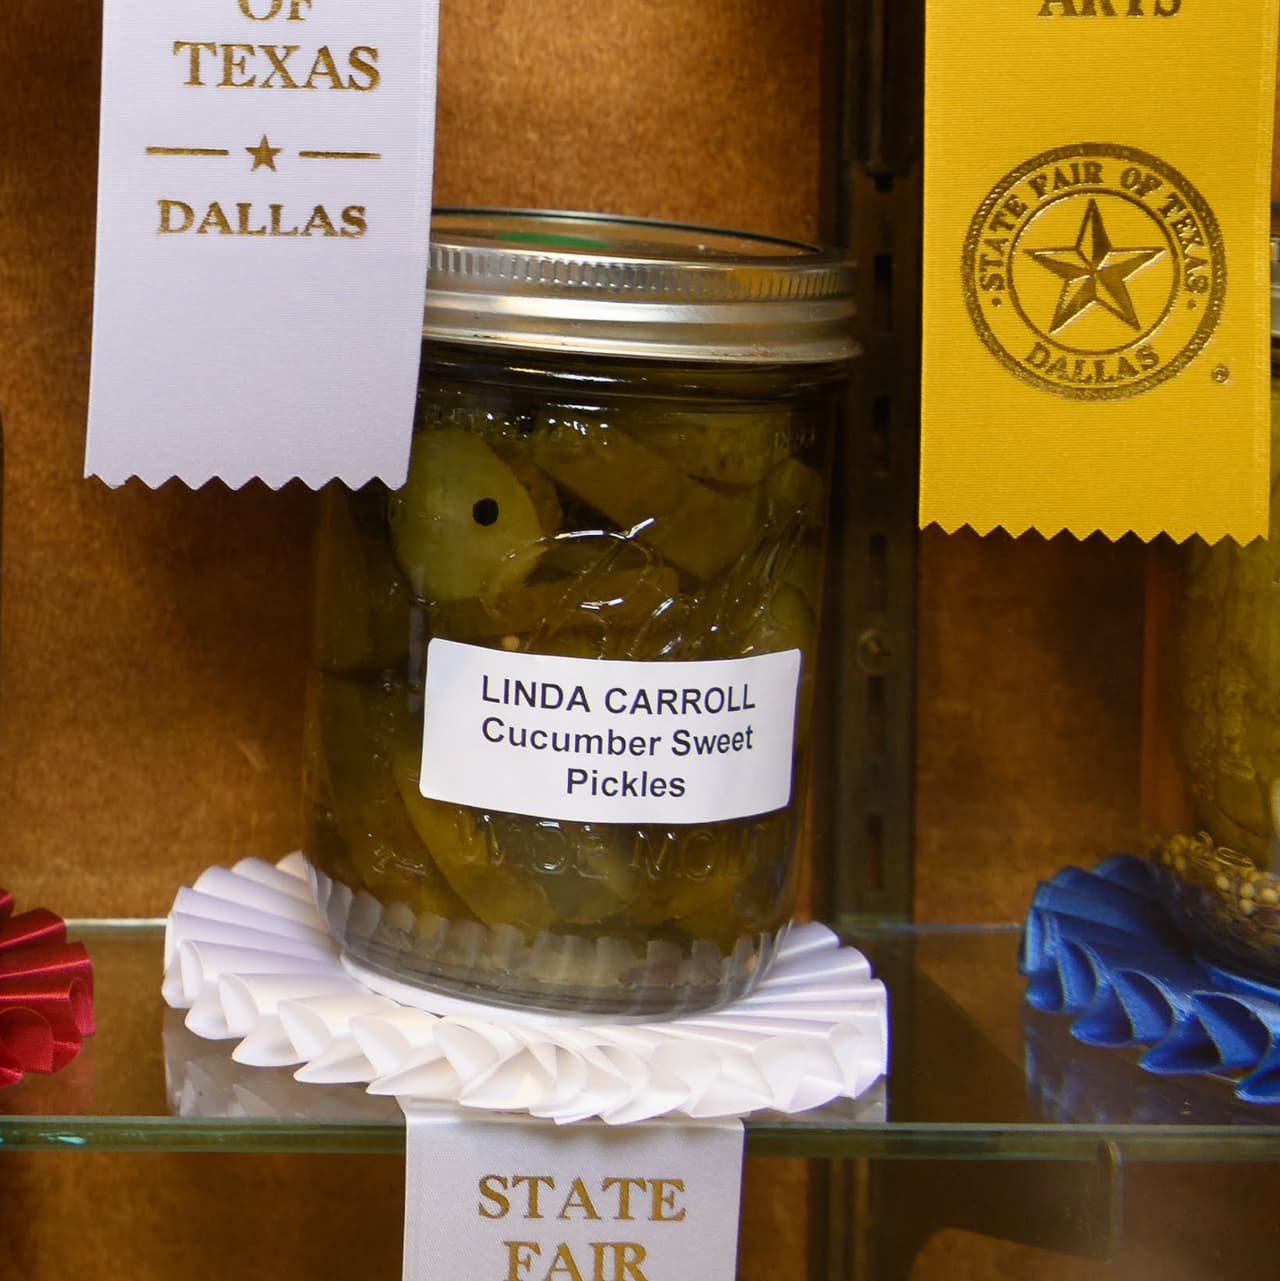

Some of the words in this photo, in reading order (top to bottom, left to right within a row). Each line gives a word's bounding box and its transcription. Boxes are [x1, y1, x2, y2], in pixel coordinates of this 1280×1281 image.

[172, 40, 382, 92] TEXAS
[157, 198, 368, 238] DALLAS
[979, 196, 1029, 293] STATE
[1029, 160, 1104, 200] FAIR
[1120, 167, 1164, 197] OF
[1157, 193, 1209, 294] TEXAS
[1024, 341, 1160, 384] DALLAS
[481, 675, 591, 713] LINDA
[604, 684, 756, 715] CARROLL
[481, 716, 661, 756] Cucumber
[671, 725, 753, 756] Sweet
[566, 768, 686, 798] Pickles
[477, 1174, 687, 1221] STATE
[503, 1241, 650, 1281] FAIR
